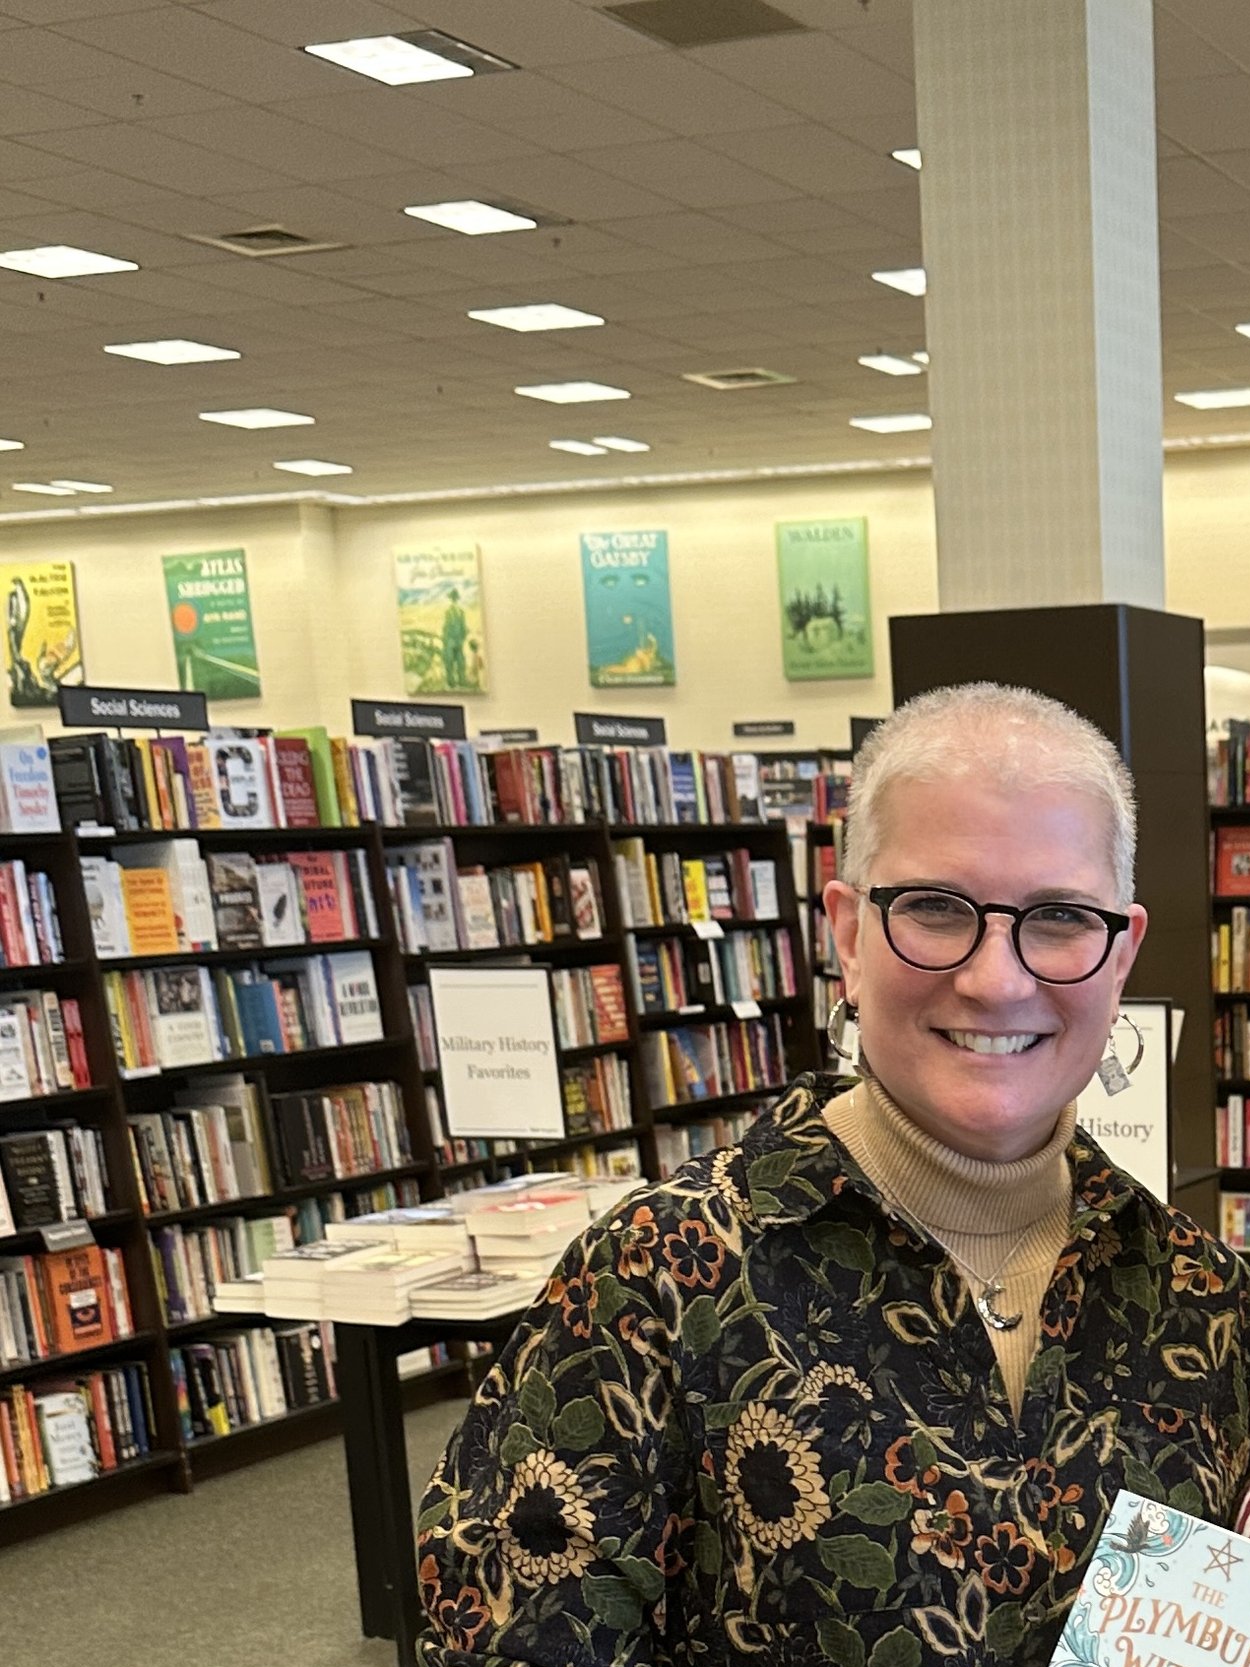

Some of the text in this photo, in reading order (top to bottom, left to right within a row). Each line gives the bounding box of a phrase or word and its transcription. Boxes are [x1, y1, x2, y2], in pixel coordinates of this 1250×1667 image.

[200, 558, 244, 577] ATLAS
[90, 697, 181, 718] Social Sciences
[441, 1036, 550, 1055] Military History
[467, 1064, 531, 1080] Favorites
[1080, 1117, 1154, 1142] History
[1192, 1581, 1228, 1609] THE
